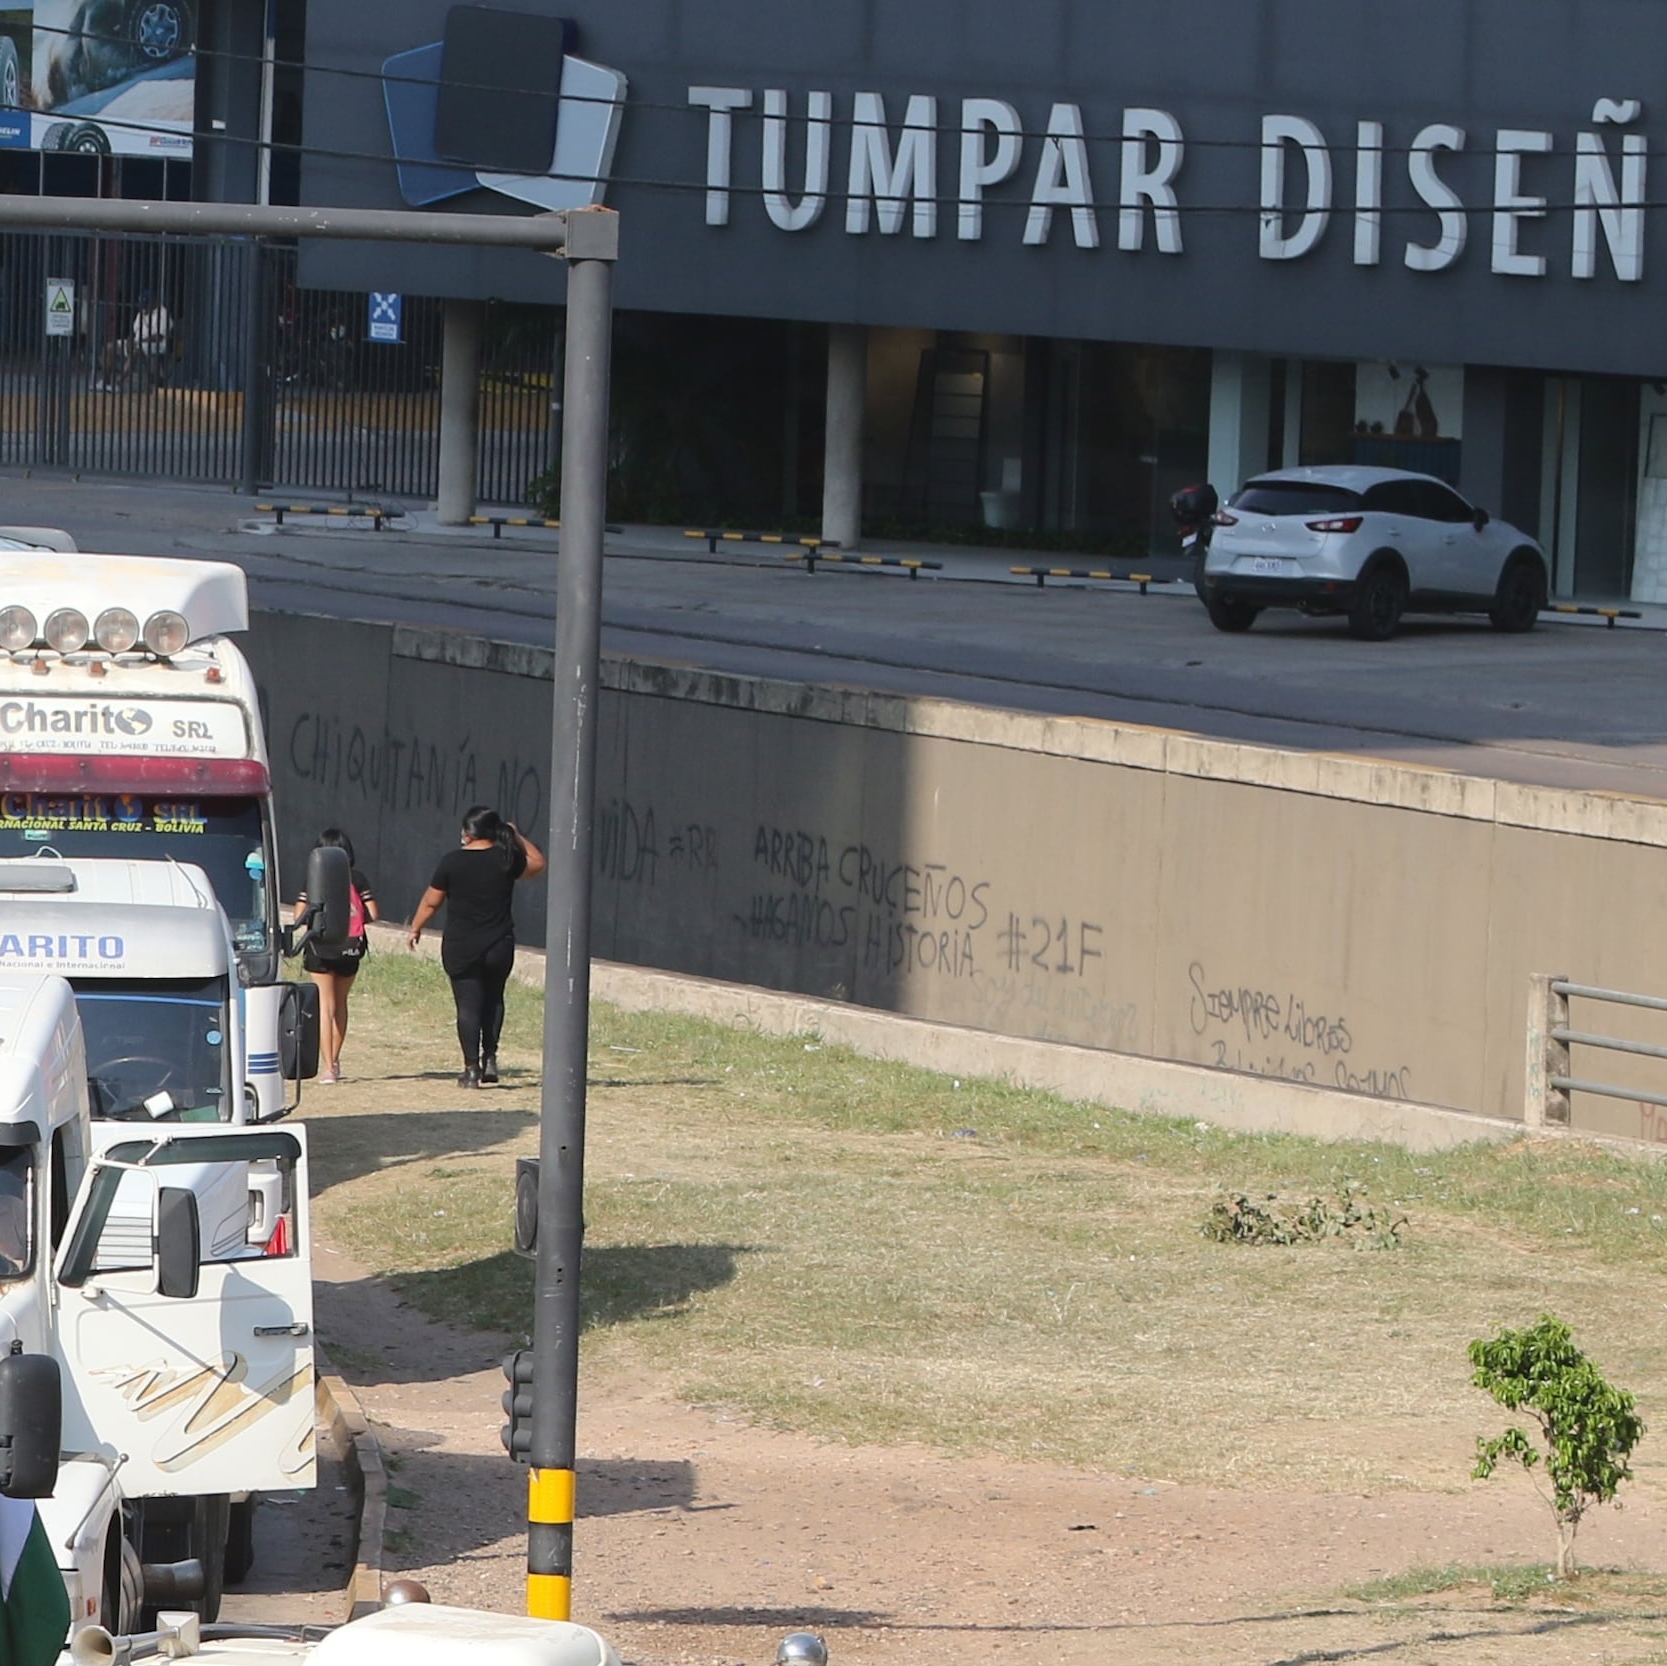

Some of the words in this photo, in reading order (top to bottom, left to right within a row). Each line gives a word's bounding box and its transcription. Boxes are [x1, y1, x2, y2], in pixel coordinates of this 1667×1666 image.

[687, 84, 1184, 255] TUMPAR
[68, 820, 108, 832] SANTA
[111, 821, 144, 833] CRUZ
[155, 822, 204, 834] BOLIVIA
[56, 961, 125, 970] Internacional
